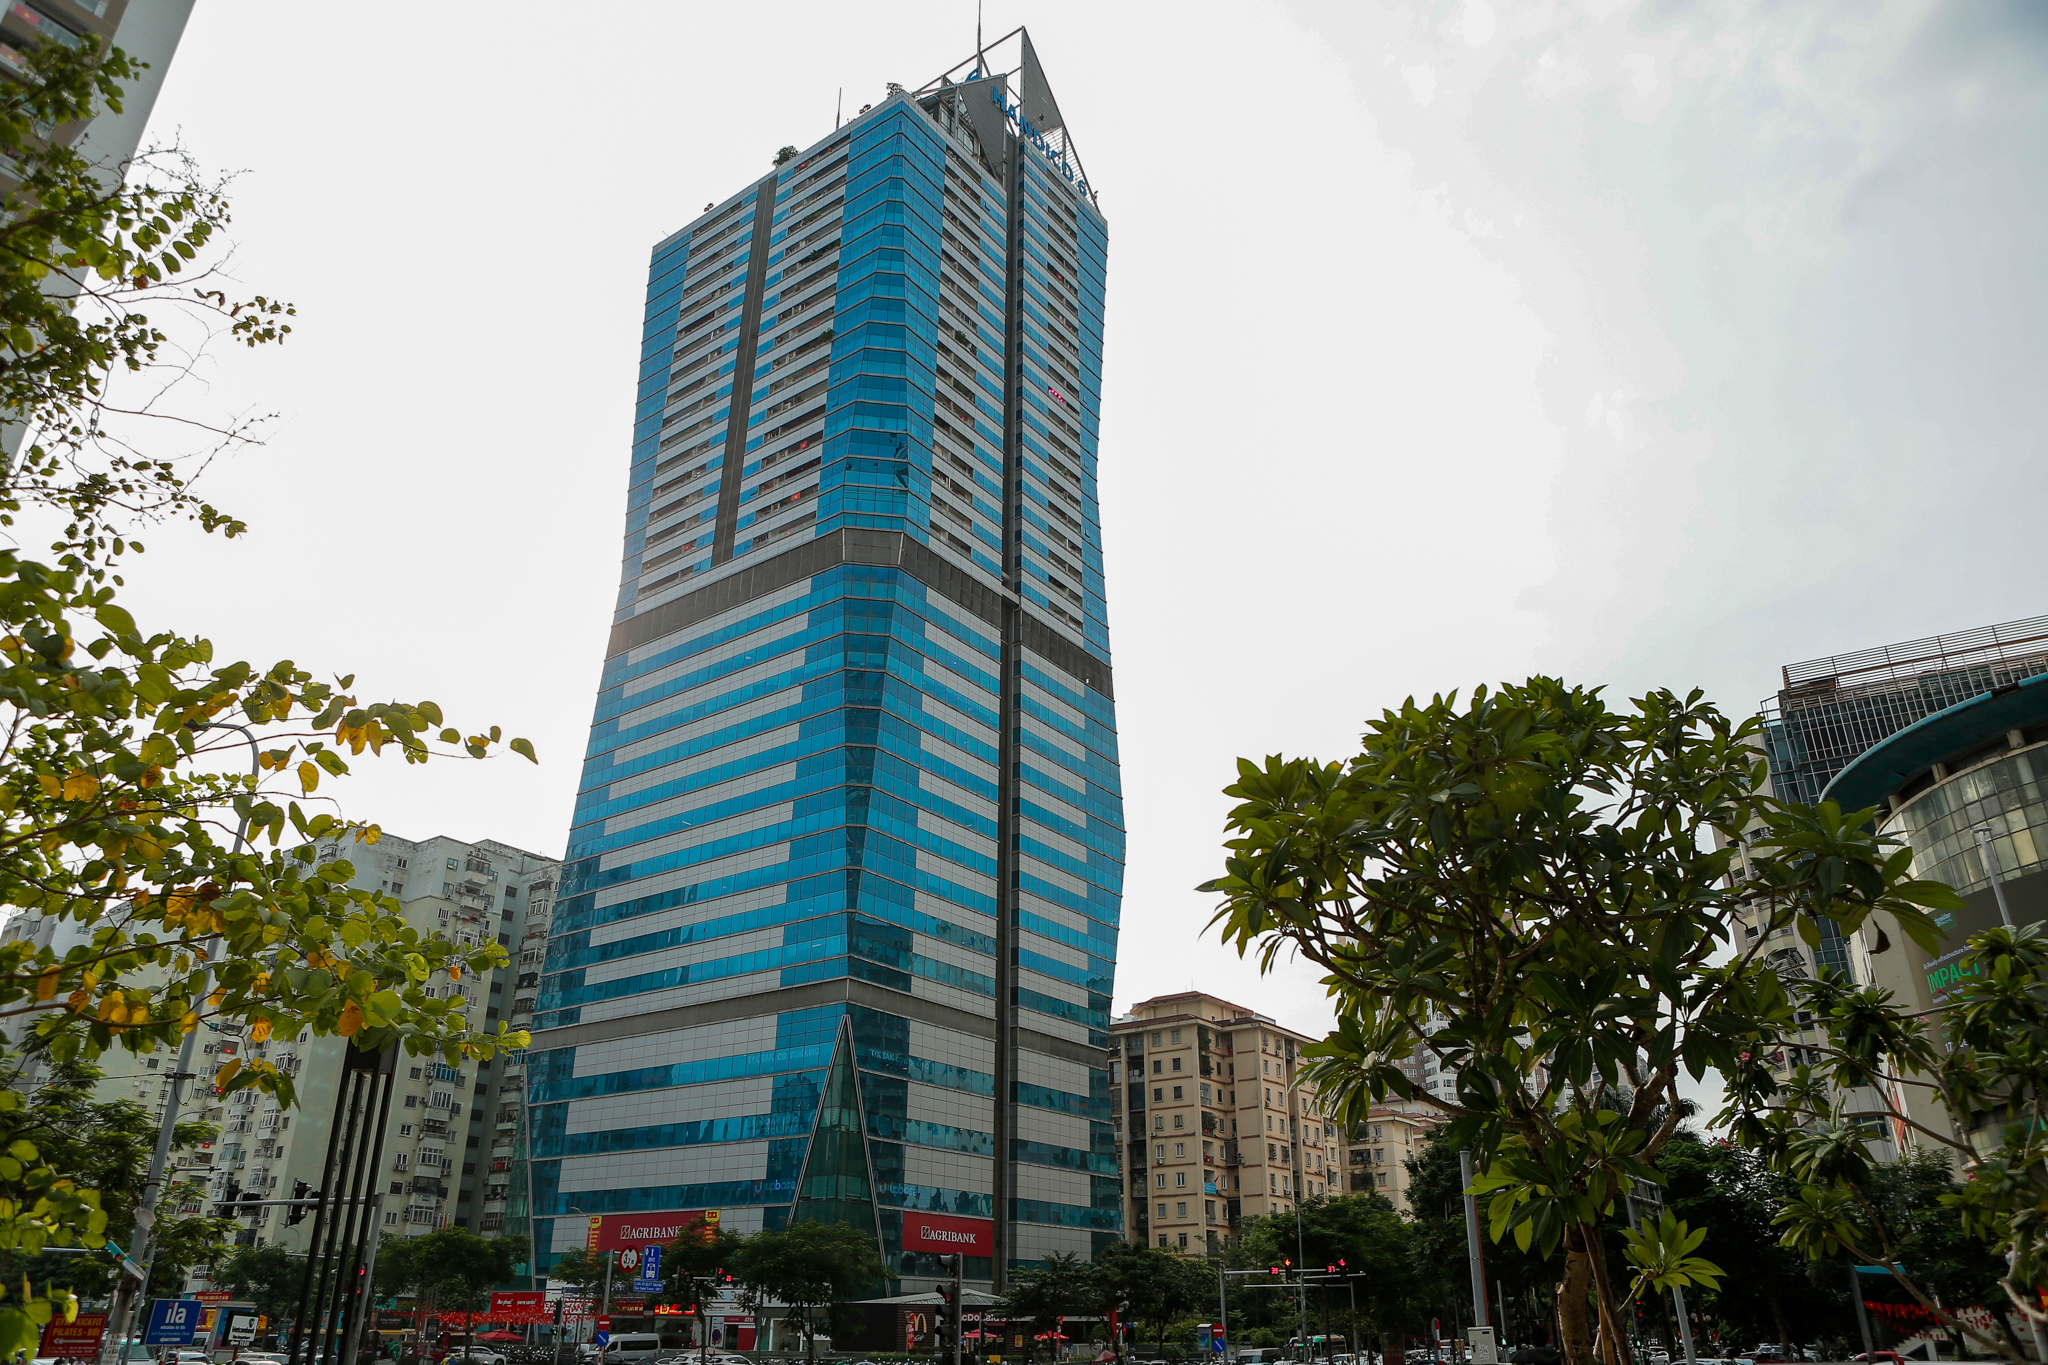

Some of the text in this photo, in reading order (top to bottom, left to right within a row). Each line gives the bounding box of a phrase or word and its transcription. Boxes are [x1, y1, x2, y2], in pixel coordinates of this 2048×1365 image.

[630, 1225, 682, 1239] AGRIBANK
[929, 1229, 976, 1244] AGRIBANK
[165, 1302, 187, 1324] ila
[76, 1317, 103, 1326] KICKFIT
[52, 1327, 83, 1336] PILATES
